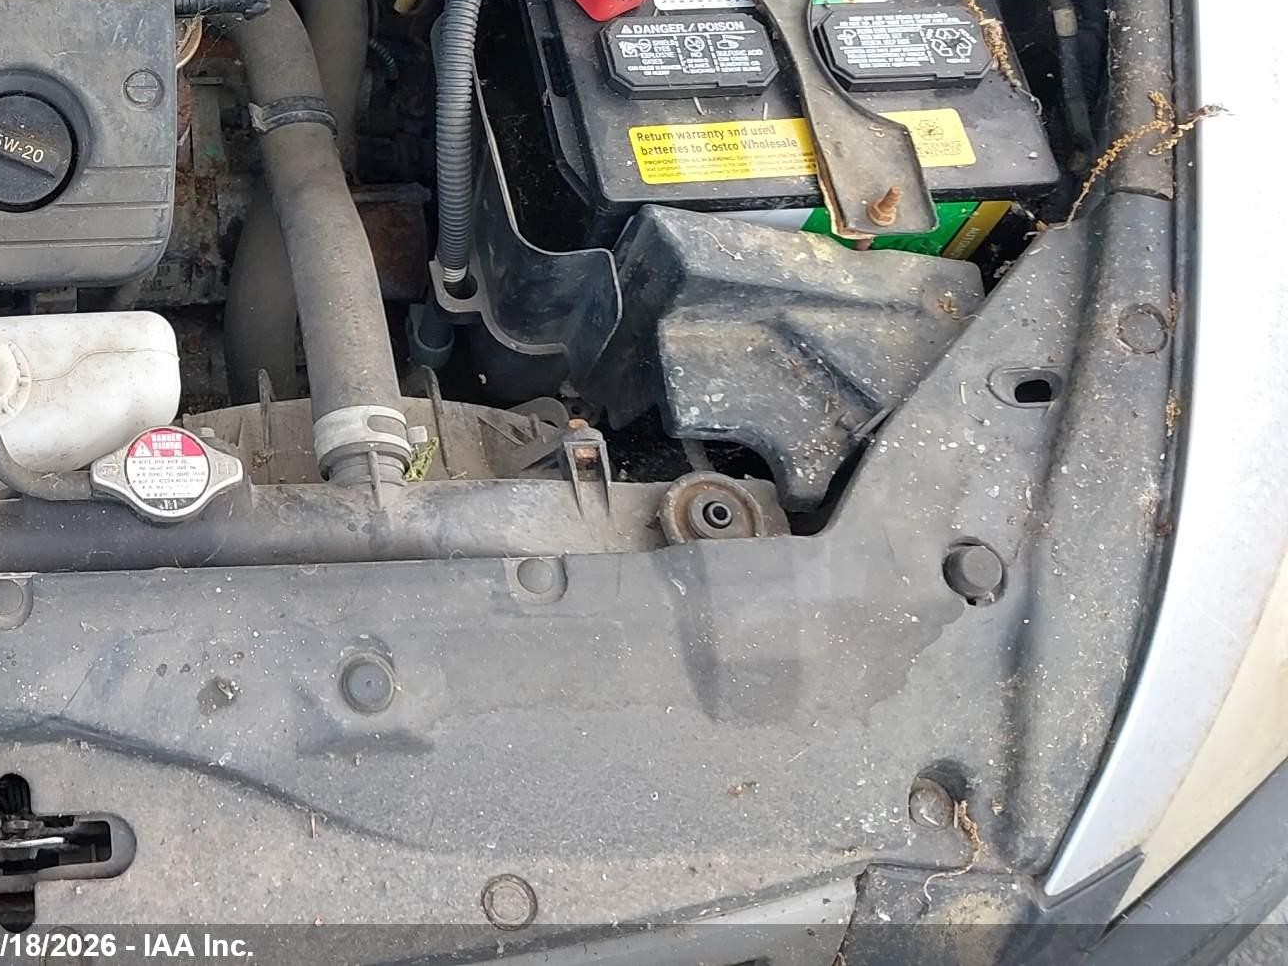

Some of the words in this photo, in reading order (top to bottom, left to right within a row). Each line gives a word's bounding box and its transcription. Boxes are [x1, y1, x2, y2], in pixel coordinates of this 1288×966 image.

[632, 23, 687, 34] DANGER
[697, 21, 746, 32] POISON
[637, 132, 673, 142] Return
[676, 130, 724, 141] warranty
[728, 127, 748, 137] and
[750, 125, 776, 136] used
[641, 144, 689, 156] batteries
[691, 143, 702, 153] to
[704, 141, 739, 152] Costco
[740, 137, 798, 151] Wholesale
